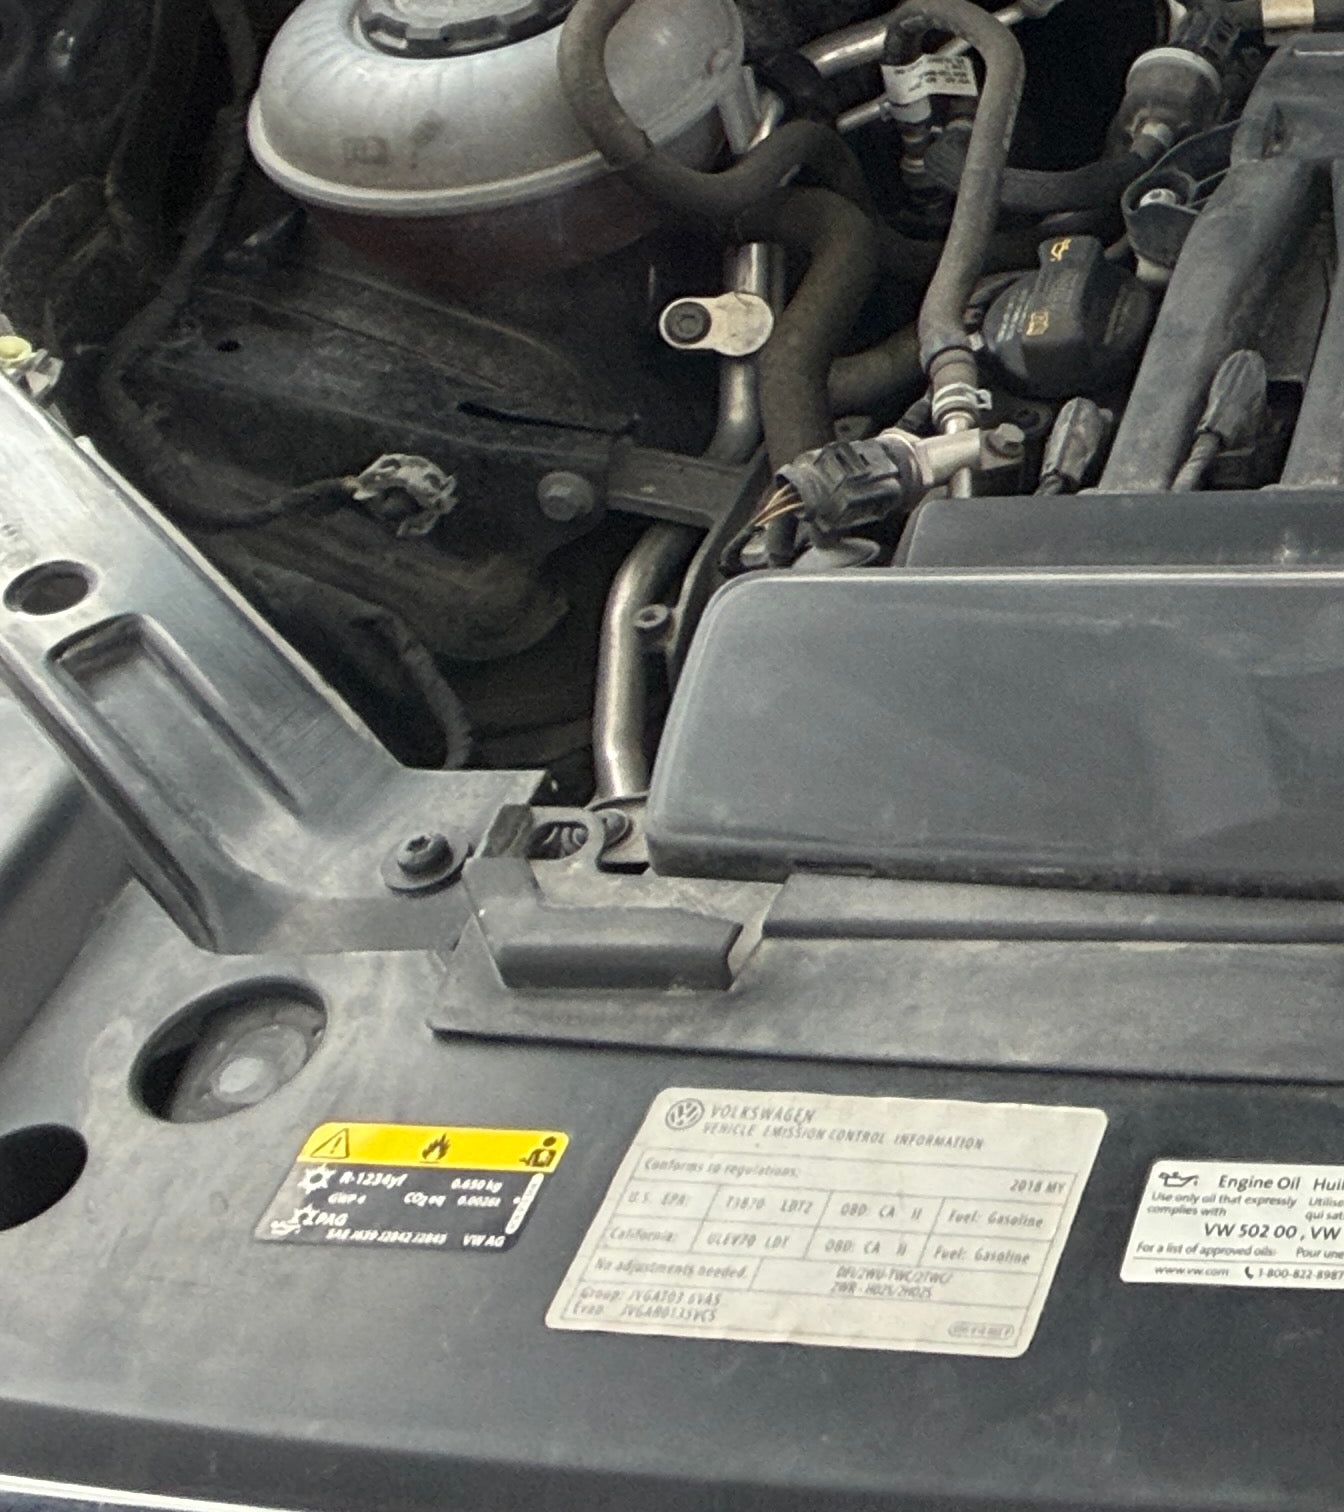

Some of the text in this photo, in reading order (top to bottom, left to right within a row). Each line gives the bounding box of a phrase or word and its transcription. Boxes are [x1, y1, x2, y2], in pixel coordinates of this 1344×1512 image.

[710, 1104, 816, 1122] VOLKSWAGEN
[702, 1122, 984, 1150] VEHICLE EMISSION CONTROL INFORMATION
[1010, 1179, 1066, 1194] 2018 MY
[1219, 1174, 1272, 1191] Engine
[1278, 1177, 1300, 1190] Oil
[1152, 1193, 1296, 1208] Use only oil that expressly
[879, 1204, 895, 1218] CA
[988, 1213, 1043, 1228] Gasoline
[1147, 1205, 1227, 1216] complies with
[1305, 1211, 1323, 1221] qui
[1204, 1223, 1235, 1236] VW
[1239, 1224, 1270, 1237] 502
[1274, 1226, 1296, 1238] 00
[1310, 1227, 1341, 1240] VW
[864, 1241, 1030, 1264] CA Gasoline
[1137, 1242, 1251, 1258] For list of approved
[1296, 1247, 1320, 1258] Pour
[1324, 1250, 1344, 1258] une
[616, 1260, 693, 1278] adjustments
[1155, 1266, 1229, 1276] www.vw.com
